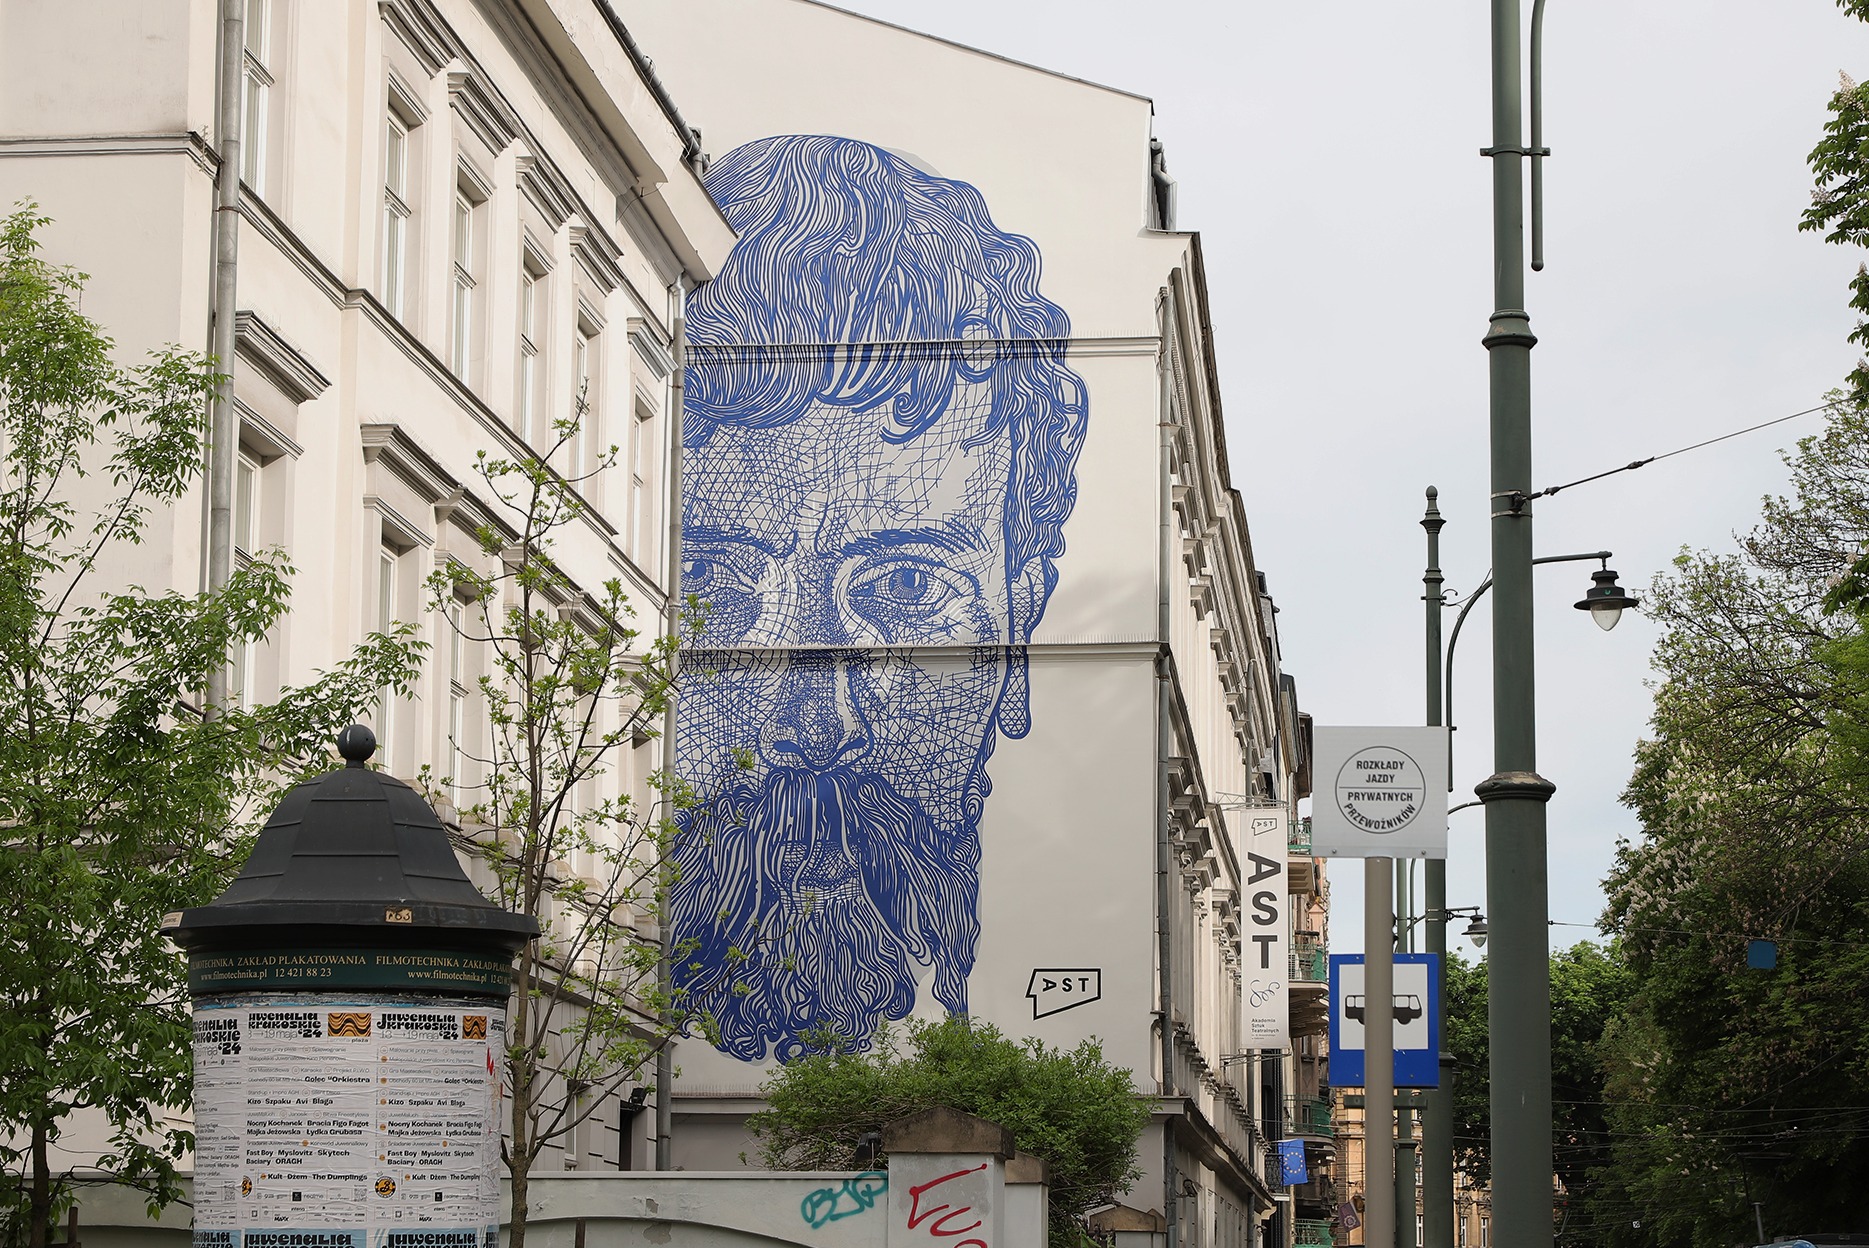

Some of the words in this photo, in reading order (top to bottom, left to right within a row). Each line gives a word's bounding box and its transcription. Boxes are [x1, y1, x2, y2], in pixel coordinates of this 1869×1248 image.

[1356, 760, 1405, 770] ROZKŁADY
[1365, 774, 1395, 783] JAZDY
[1347, 792, 1413, 802] PRYWATNYCH
[1344, 803, 1416, 830] PRZEWOŹNIKÓW
[1248, 851, 1282, 969] AST
[238, 956, 276, 967] ZAKŁAD
[278, 956, 366, 966] PLAKATOWANIA
[376, 956, 460, 968] FILMOTECHNIKA
[462, 958, 492, 970] ZAKŁAD
[201, 969, 268, 981] www.filmotechnika.pl
[275, 968, 284, 977] 12
[287, 968, 303, 977] 421
[306, 968, 318, 977] 88
[320, 968, 332, 977] 23
[408, 971, 486, 984] www.filmotechnika.pl
[1042, 978, 1089, 992] AST
[407, 1030, 417, 1039] 19
